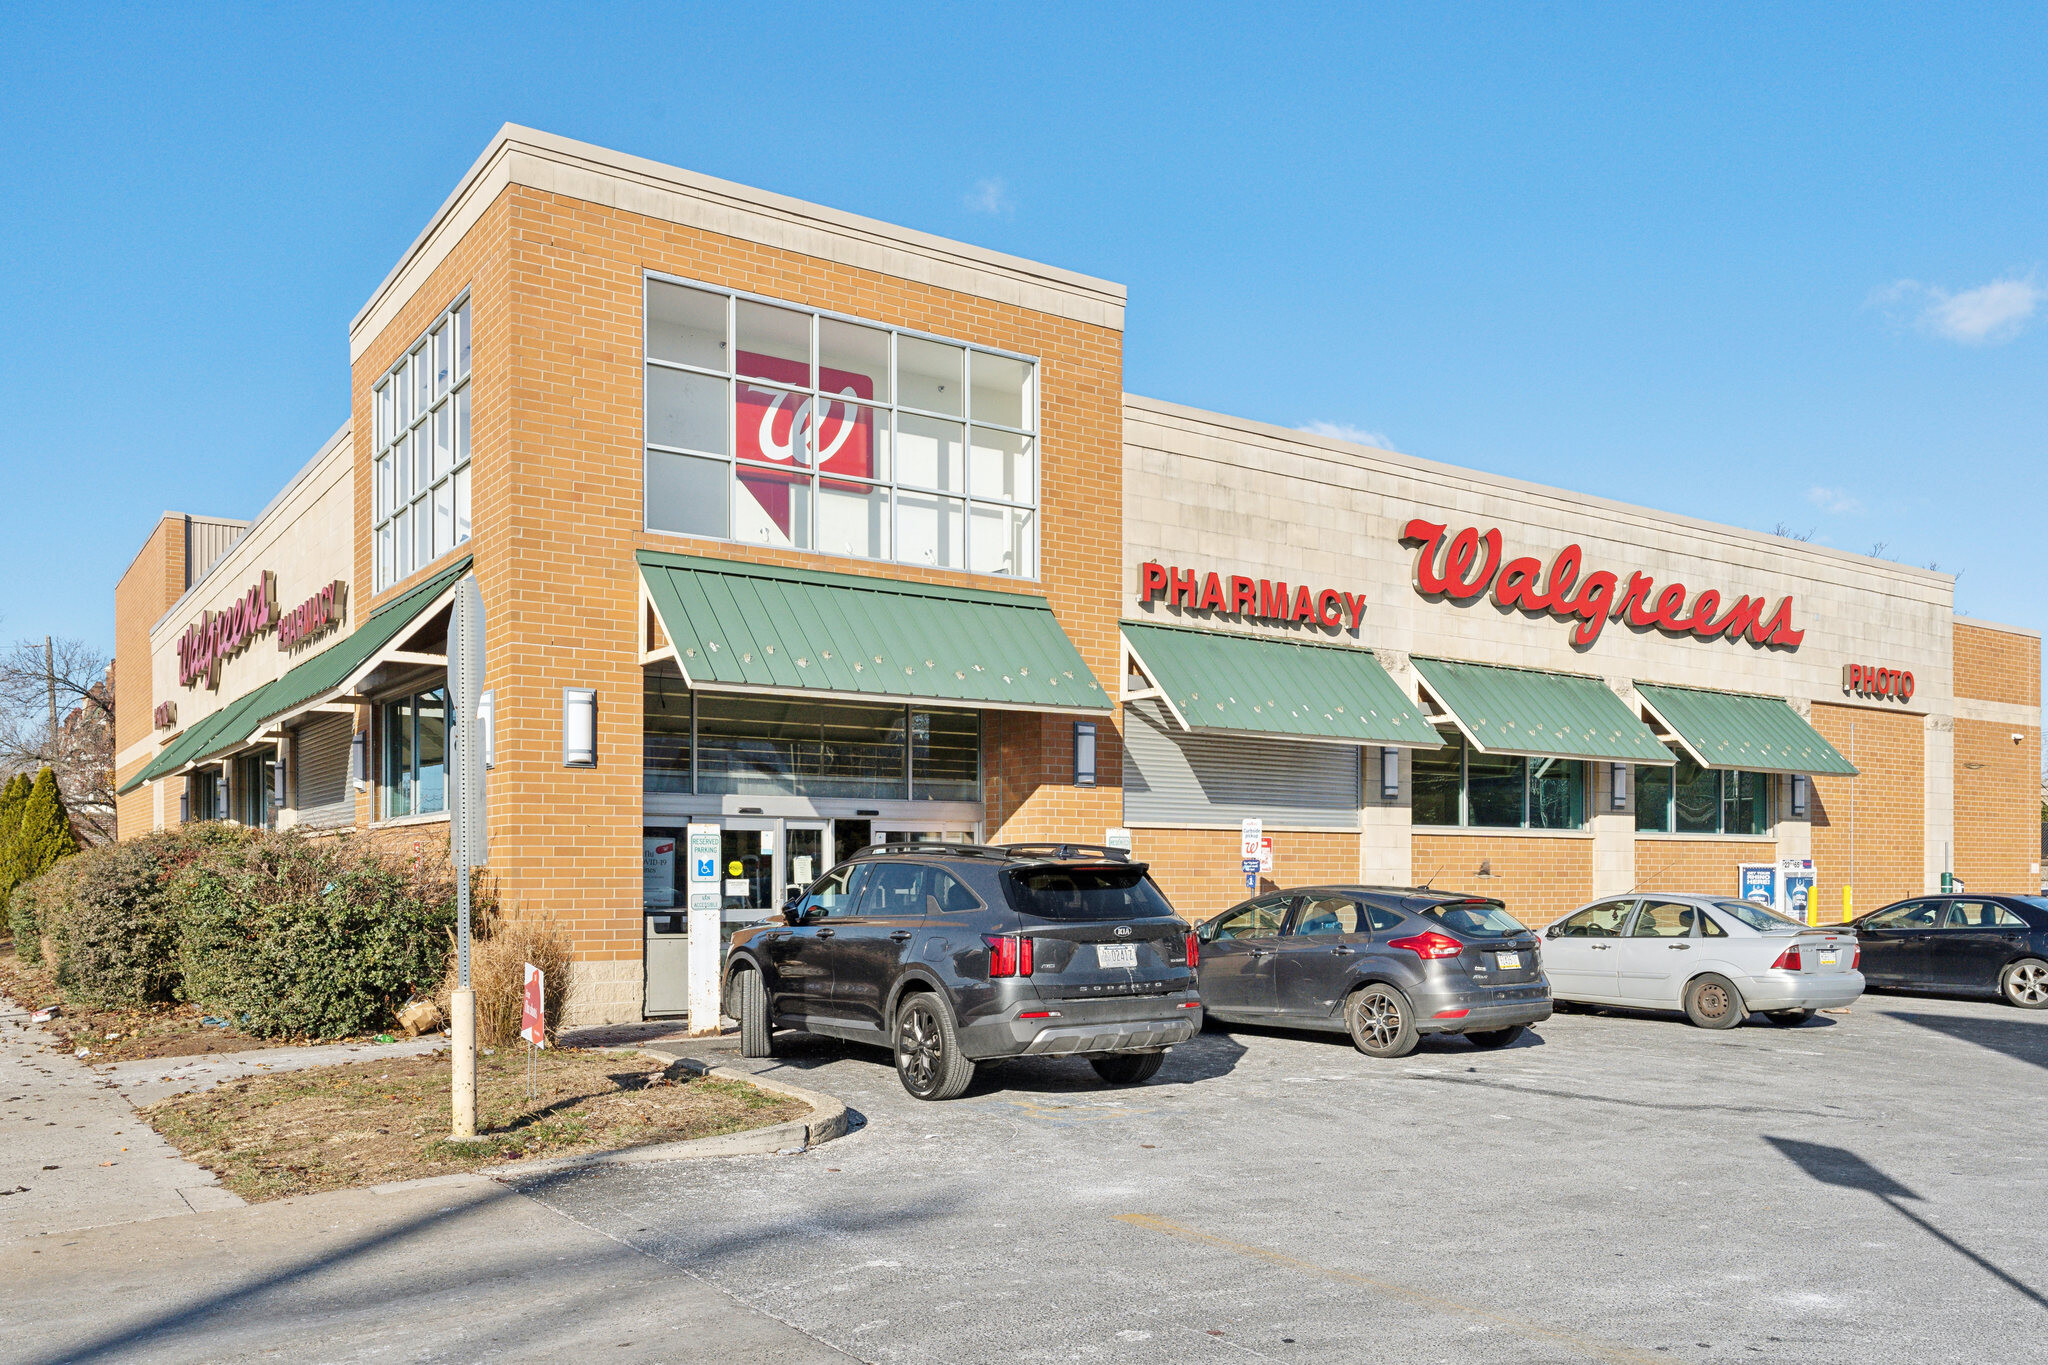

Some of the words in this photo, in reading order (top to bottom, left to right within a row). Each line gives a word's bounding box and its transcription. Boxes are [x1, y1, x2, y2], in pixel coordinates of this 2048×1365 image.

[278, 580, 338, 648] PHARMACY
[1142, 562, 1367, 629] PHARMACY
[1404, 519, 1805, 645] Walgreens
[177, 570, 270, 690] Walgreens
[1849, 663, 1914, 698] PHOTO
[695, 846, 717, 854] PARKING
[1080, 982, 1162, 991] SORENTO
